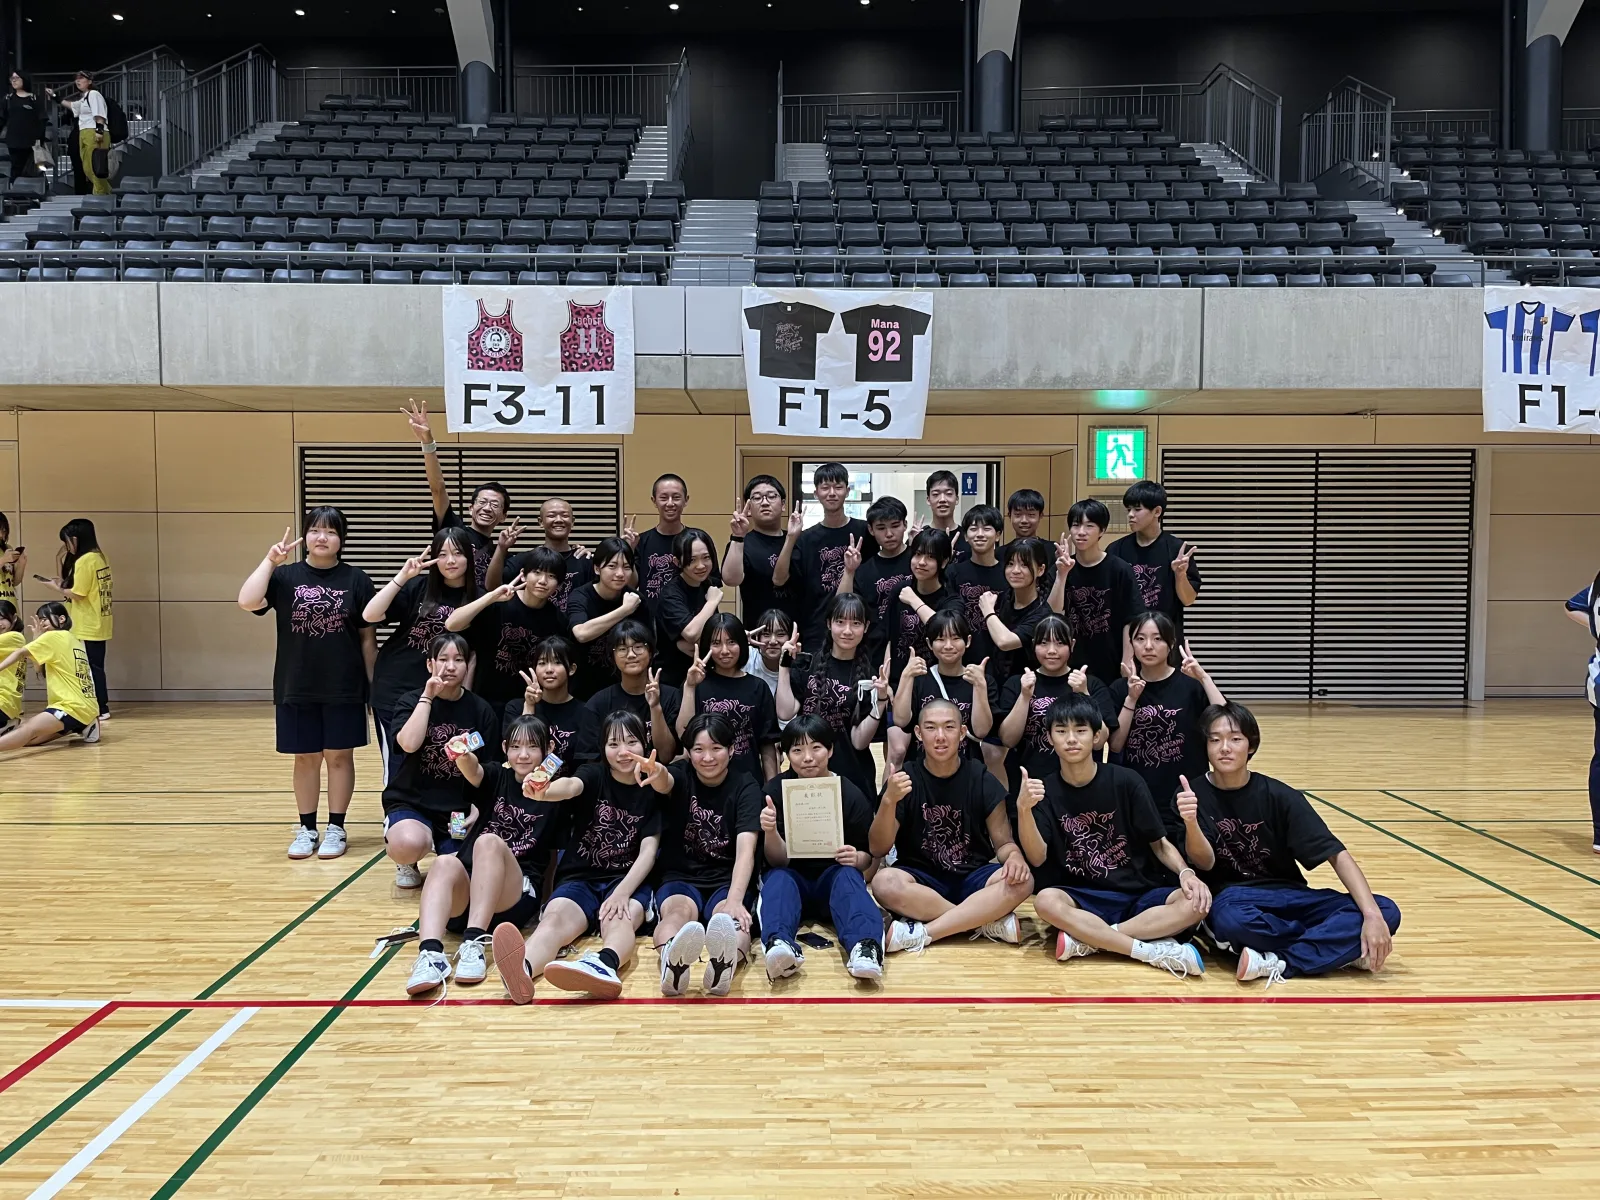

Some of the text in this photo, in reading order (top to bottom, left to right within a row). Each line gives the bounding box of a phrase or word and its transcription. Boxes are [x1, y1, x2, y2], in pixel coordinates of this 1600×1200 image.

[576, 327, 599, 353] 11
[871, 318, 900, 329] Mana
[868, 330, 901, 362] 92
[463, 383, 605, 426] F3-11
[778, 386, 892, 431] F1-5
[1518, 384, 1600, 426] F1-
